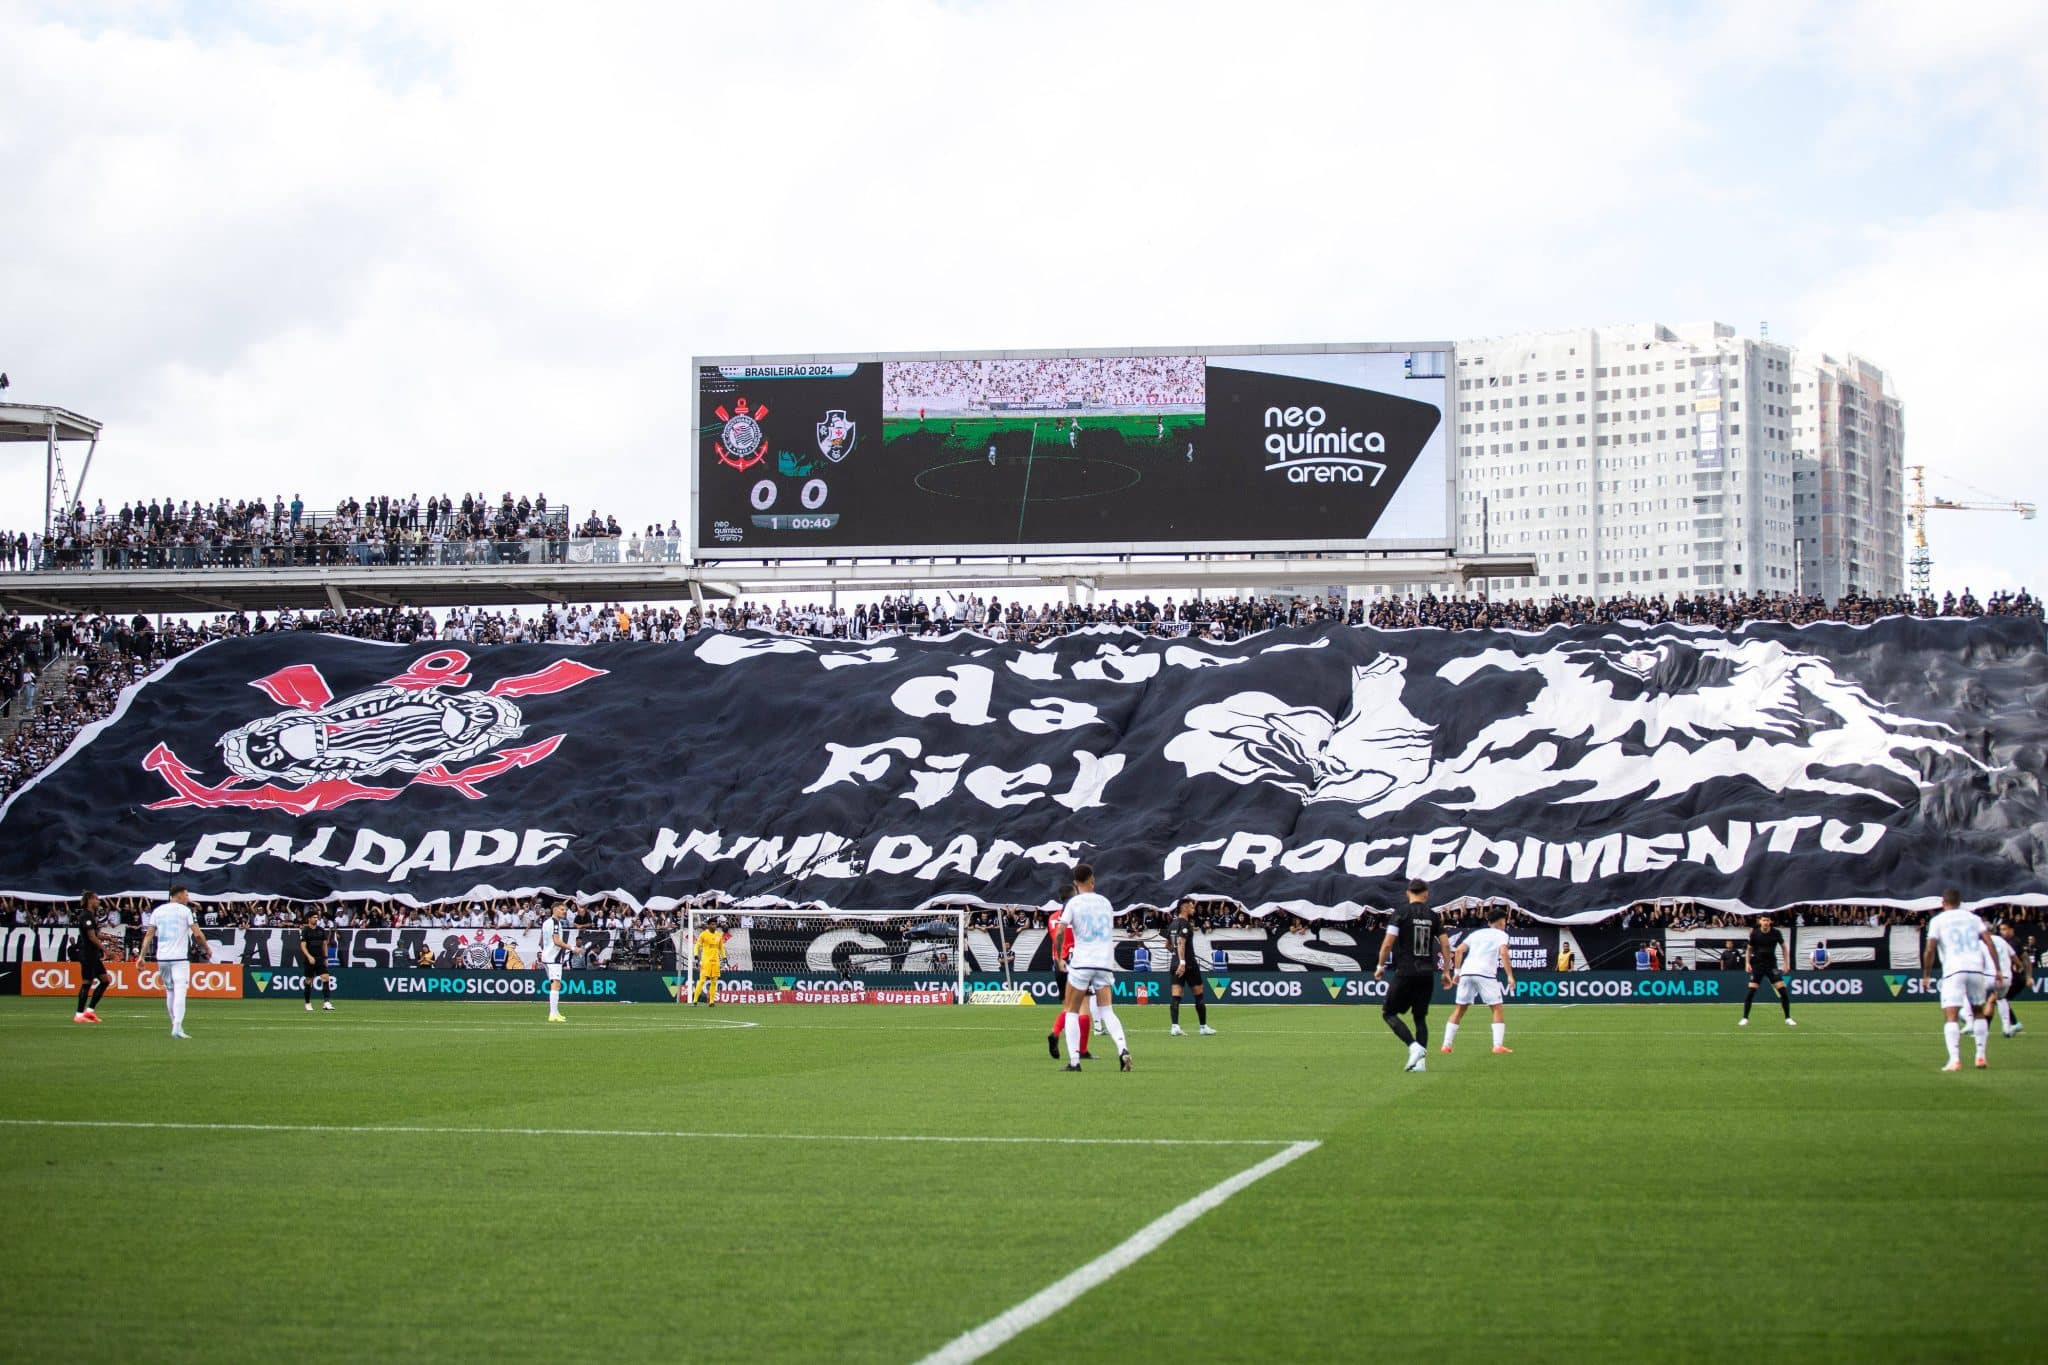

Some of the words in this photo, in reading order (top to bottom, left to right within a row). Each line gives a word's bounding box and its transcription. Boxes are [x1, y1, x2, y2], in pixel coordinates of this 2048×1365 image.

[745, 365, 807, 377] BRASILEIRÃO
[808, 365, 833, 375] 2024
[1264, 406, 1326, 427] neo
[1264, 426, 1385, 461] química
[1287, 465, 1364, 483] arena
[750, 479, 777, 510] 0
[801, 478, 828, 509] 0
[792, 517, 831, 528] 00:40
[802, 736, 1126, 812] Fiel
[133, 825, 577, 882] LEALDADE
[1508, 936, 1540, 946] ANTANA
[32, 968, 76, 989] GOL
[191, 970, 237, 991] GOL
[383, 977, 617, 995] VEMPROSICOOB.COM.BR
[1791, 978, 1863, 995] SICOOB
[1231, 981, 1302, 997] SICOOB
[1346, 980, 1390, 996] SICO
[1500, 980, 1719, 997] MPROSICOOB.COM.BR
[714, 991, 782, 1004] SUPERBET
[795, 991, 867, 1004] SUPERBET
[876, 991, 948, 1004] SUPERBET
